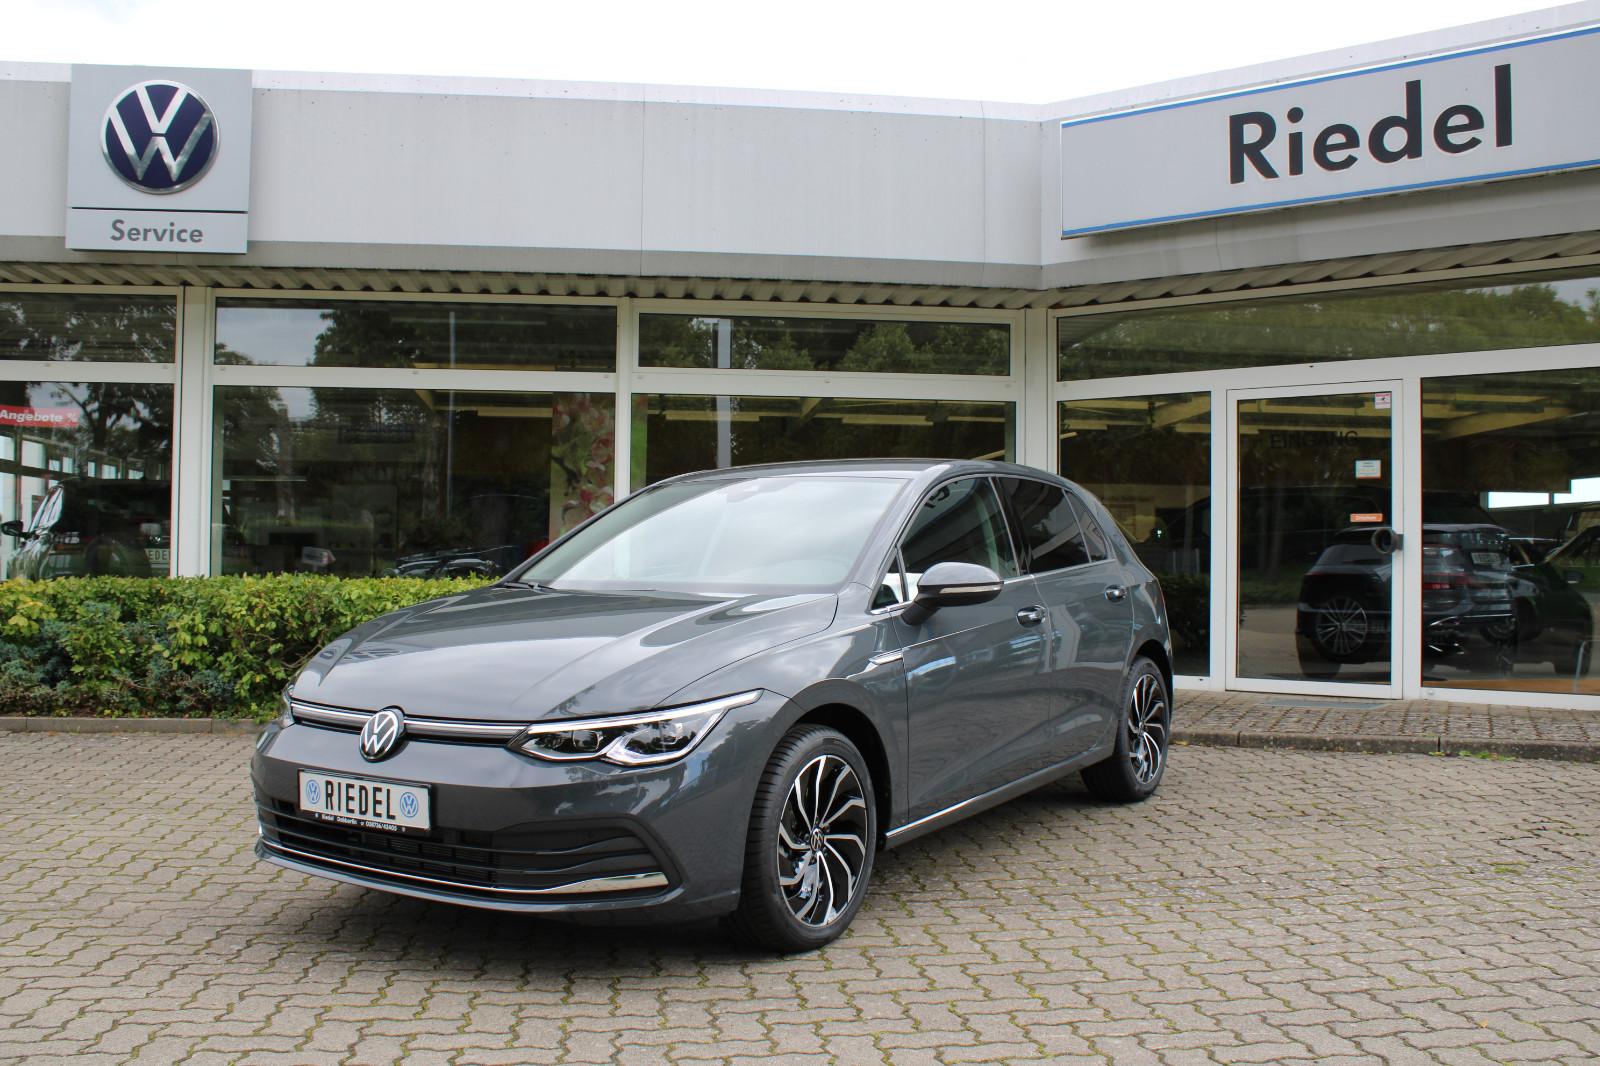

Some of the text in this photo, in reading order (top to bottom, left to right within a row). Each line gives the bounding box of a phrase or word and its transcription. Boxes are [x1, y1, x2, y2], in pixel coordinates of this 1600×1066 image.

[1229, 63, 1513, 184] Riedel
[101, 80, 219, 194] VW
[110, 219, 204, 243] Service
[0, 409, 64, 423] Angebote
[1270, 430, 1358, 449] EINGANG
[148, 549, 169, 561] EDE
[325, 780, 396, 820] RIEDEL
